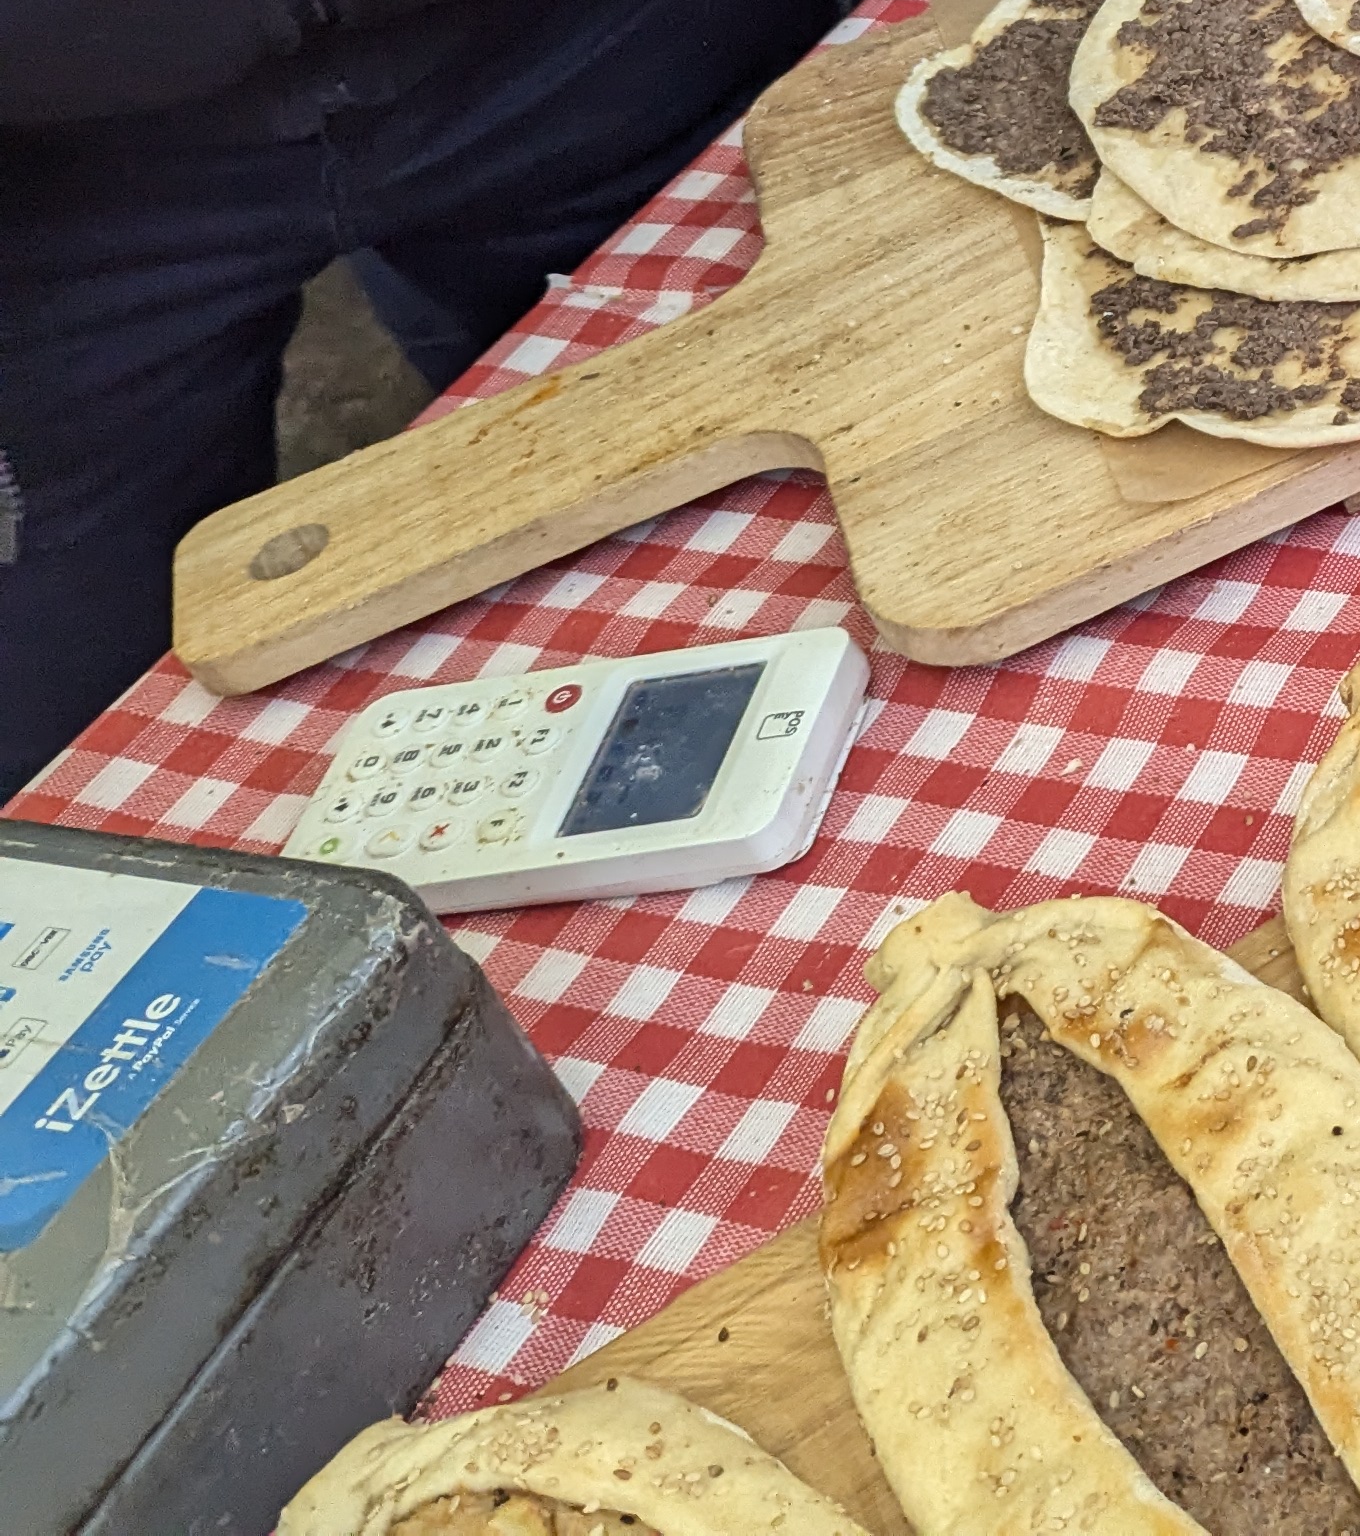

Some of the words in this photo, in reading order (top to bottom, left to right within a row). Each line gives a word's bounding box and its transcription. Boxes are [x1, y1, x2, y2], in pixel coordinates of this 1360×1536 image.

[530, 728, 550, 745] F1
[508, 770, 529, 788] F2
[58, 928, 111, 982] SAMSUNG
[80, 941, 112, 973] pay
[34, 992, 182, 1133] iZettle
[132, 1027, 176, 1075] PayPal
